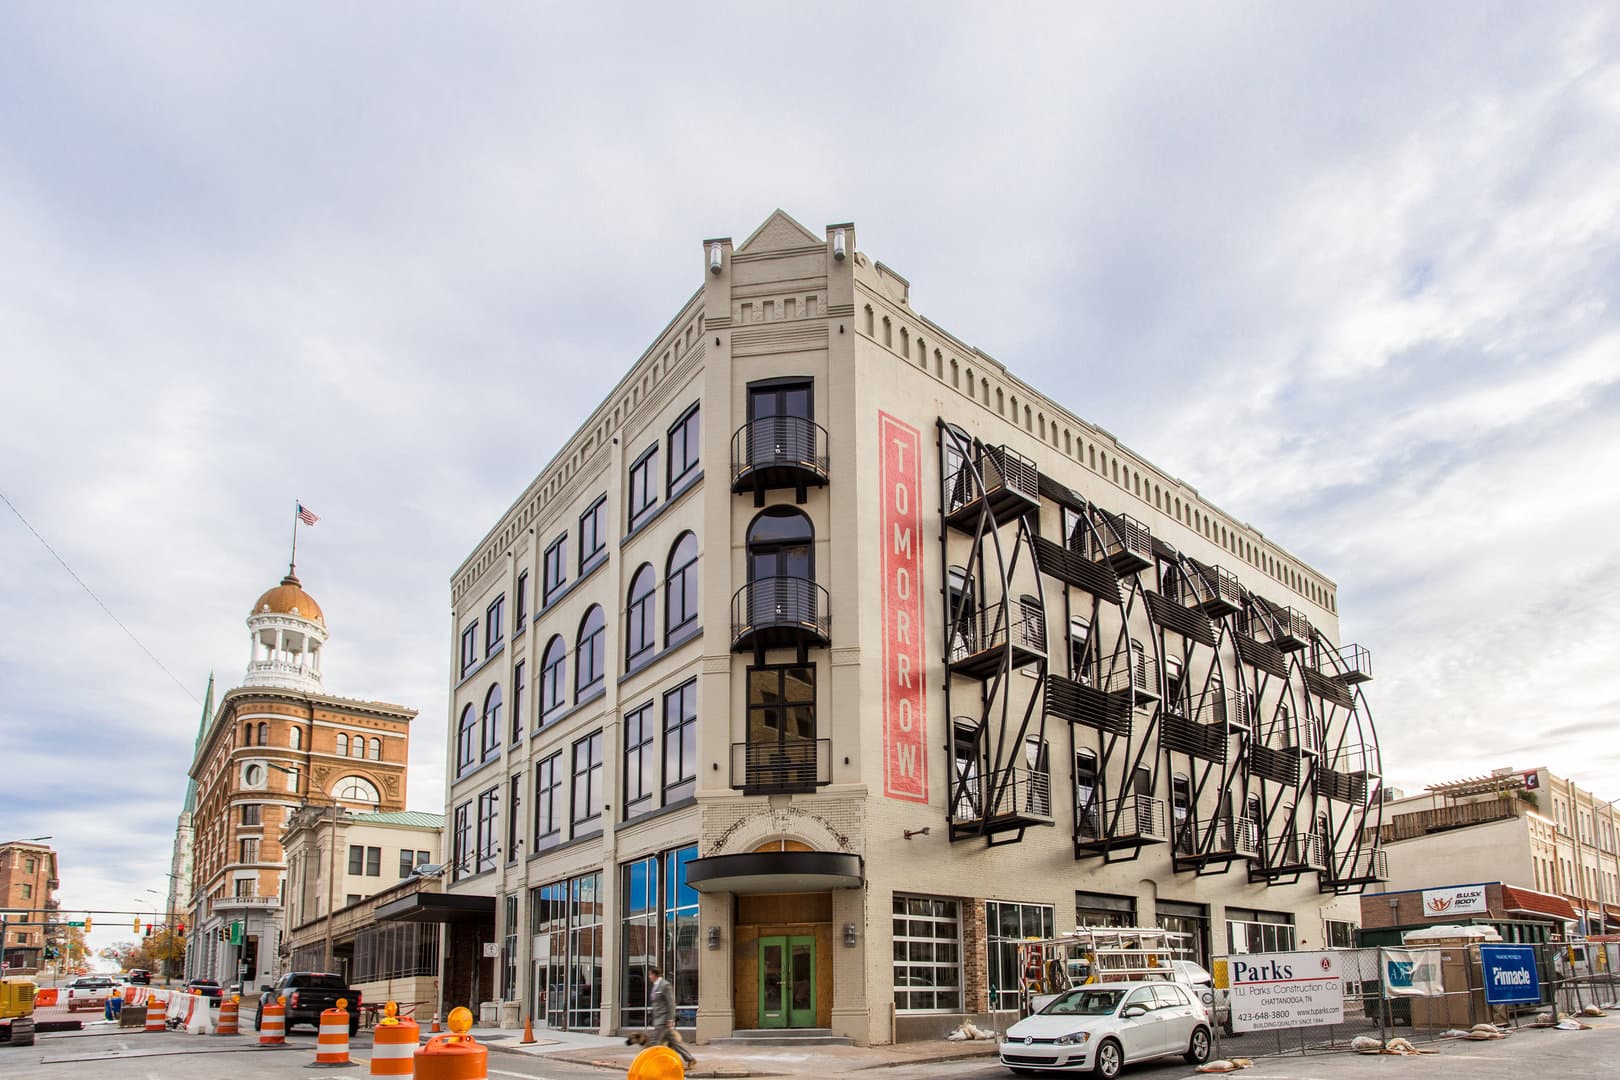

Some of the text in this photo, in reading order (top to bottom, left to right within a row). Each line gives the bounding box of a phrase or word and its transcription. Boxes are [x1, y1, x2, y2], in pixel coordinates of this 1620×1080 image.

[893, 437, 917, 778] TOMORROW
[1232, 960, 1293, 981] Parks
[1492, 966, 1531, 985] Pinnacle
[1249, 986, 1271, 996] Parks
[1273, 984, 1323, 994] Construction
[1305, 995, 1313, 1003] TN
[1237, 1010, 1289, 1021] 423-648-3800
